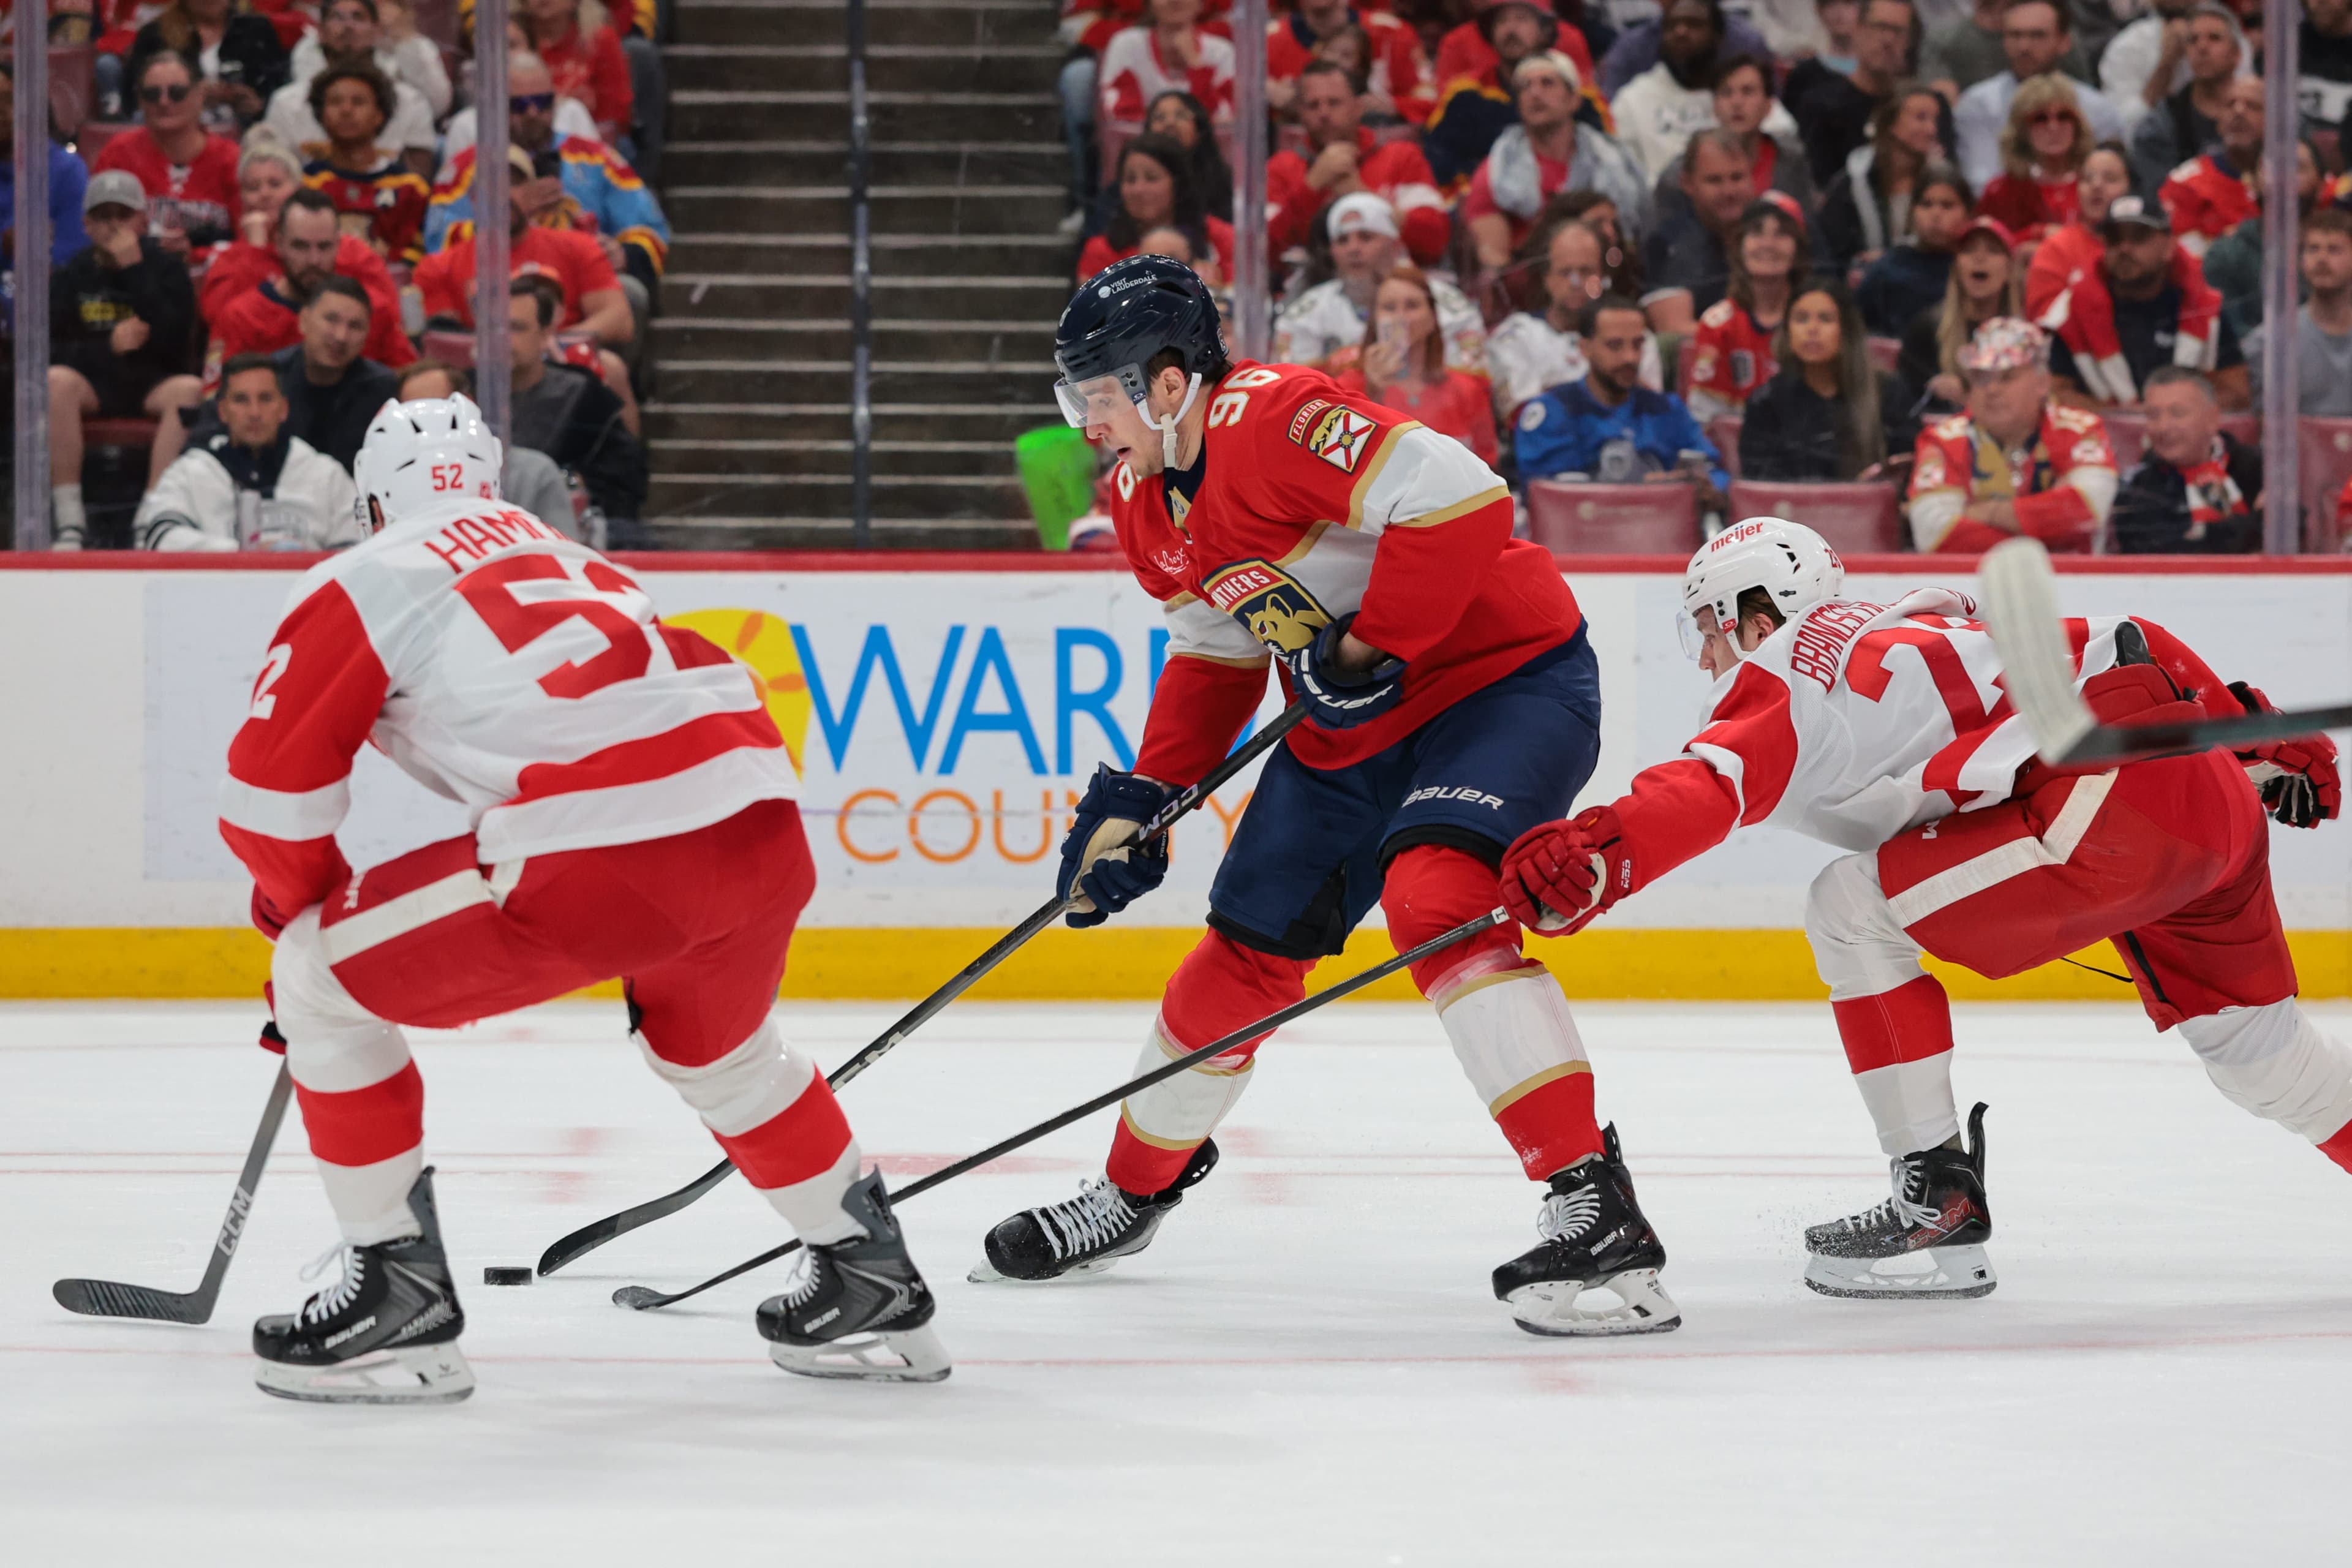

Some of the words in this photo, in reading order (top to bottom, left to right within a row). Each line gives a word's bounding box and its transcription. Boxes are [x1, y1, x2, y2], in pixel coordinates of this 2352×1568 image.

[1110, 277, 1126, 288] VISIT
[1111, 274, 1158, 294] LAUDERDALE
[1208, 368, 1281, 429] 96
[1293, 400, 1323, 436] FLORIDA
[431, 464, 464, 491] 52
[1711, 522, 1763, 552] meijer
[1844, 611, 2022, 739] 2
[1138, 783, 1199, 842] CCM
[1401, 786, 1505, 811] BAUER
[836, 788, 1256, 864] COUY
[1622, 859, 1631, 889] CCM
[217, 1185, 254, 1256] CCM
[1589, 1231, 1618, 1257] BAUER
